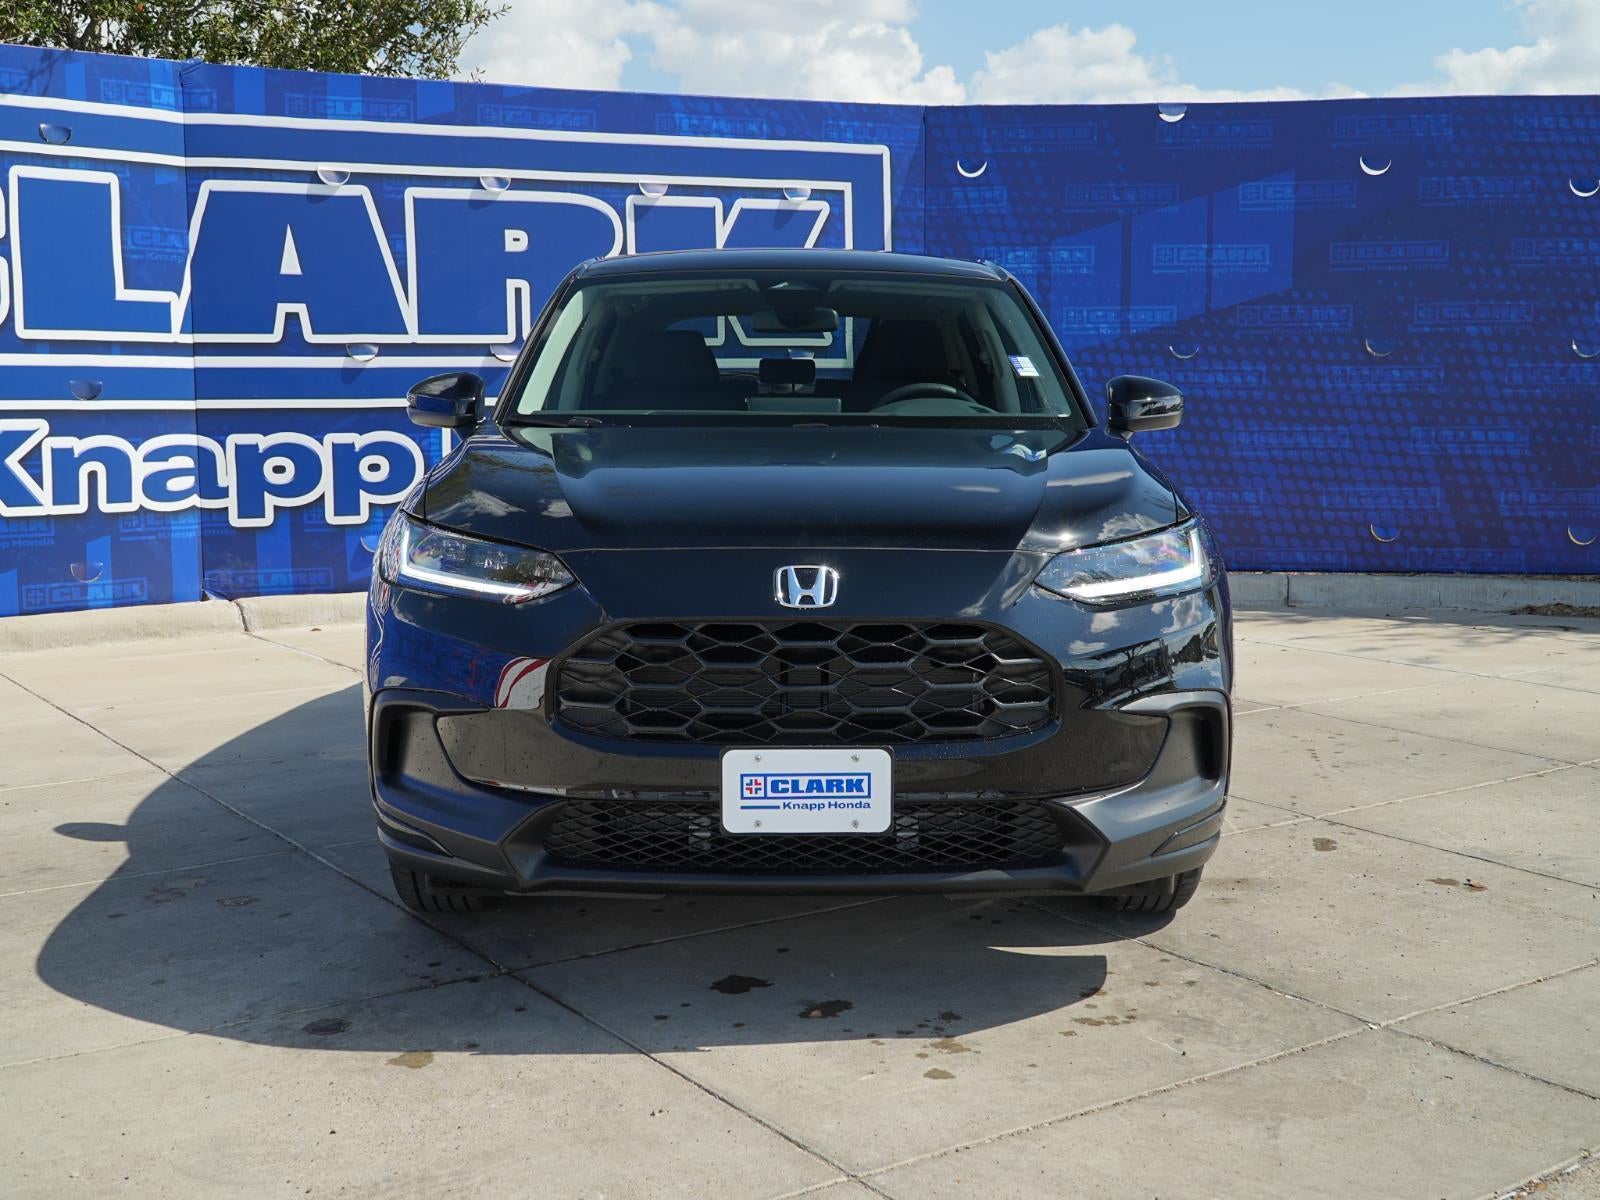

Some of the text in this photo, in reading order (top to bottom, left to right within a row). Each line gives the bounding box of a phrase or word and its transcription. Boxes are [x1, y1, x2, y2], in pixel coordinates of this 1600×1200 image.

[770, 778, 865, 794] CLARK
[782, 800, 871, 812] Knapp Honda
